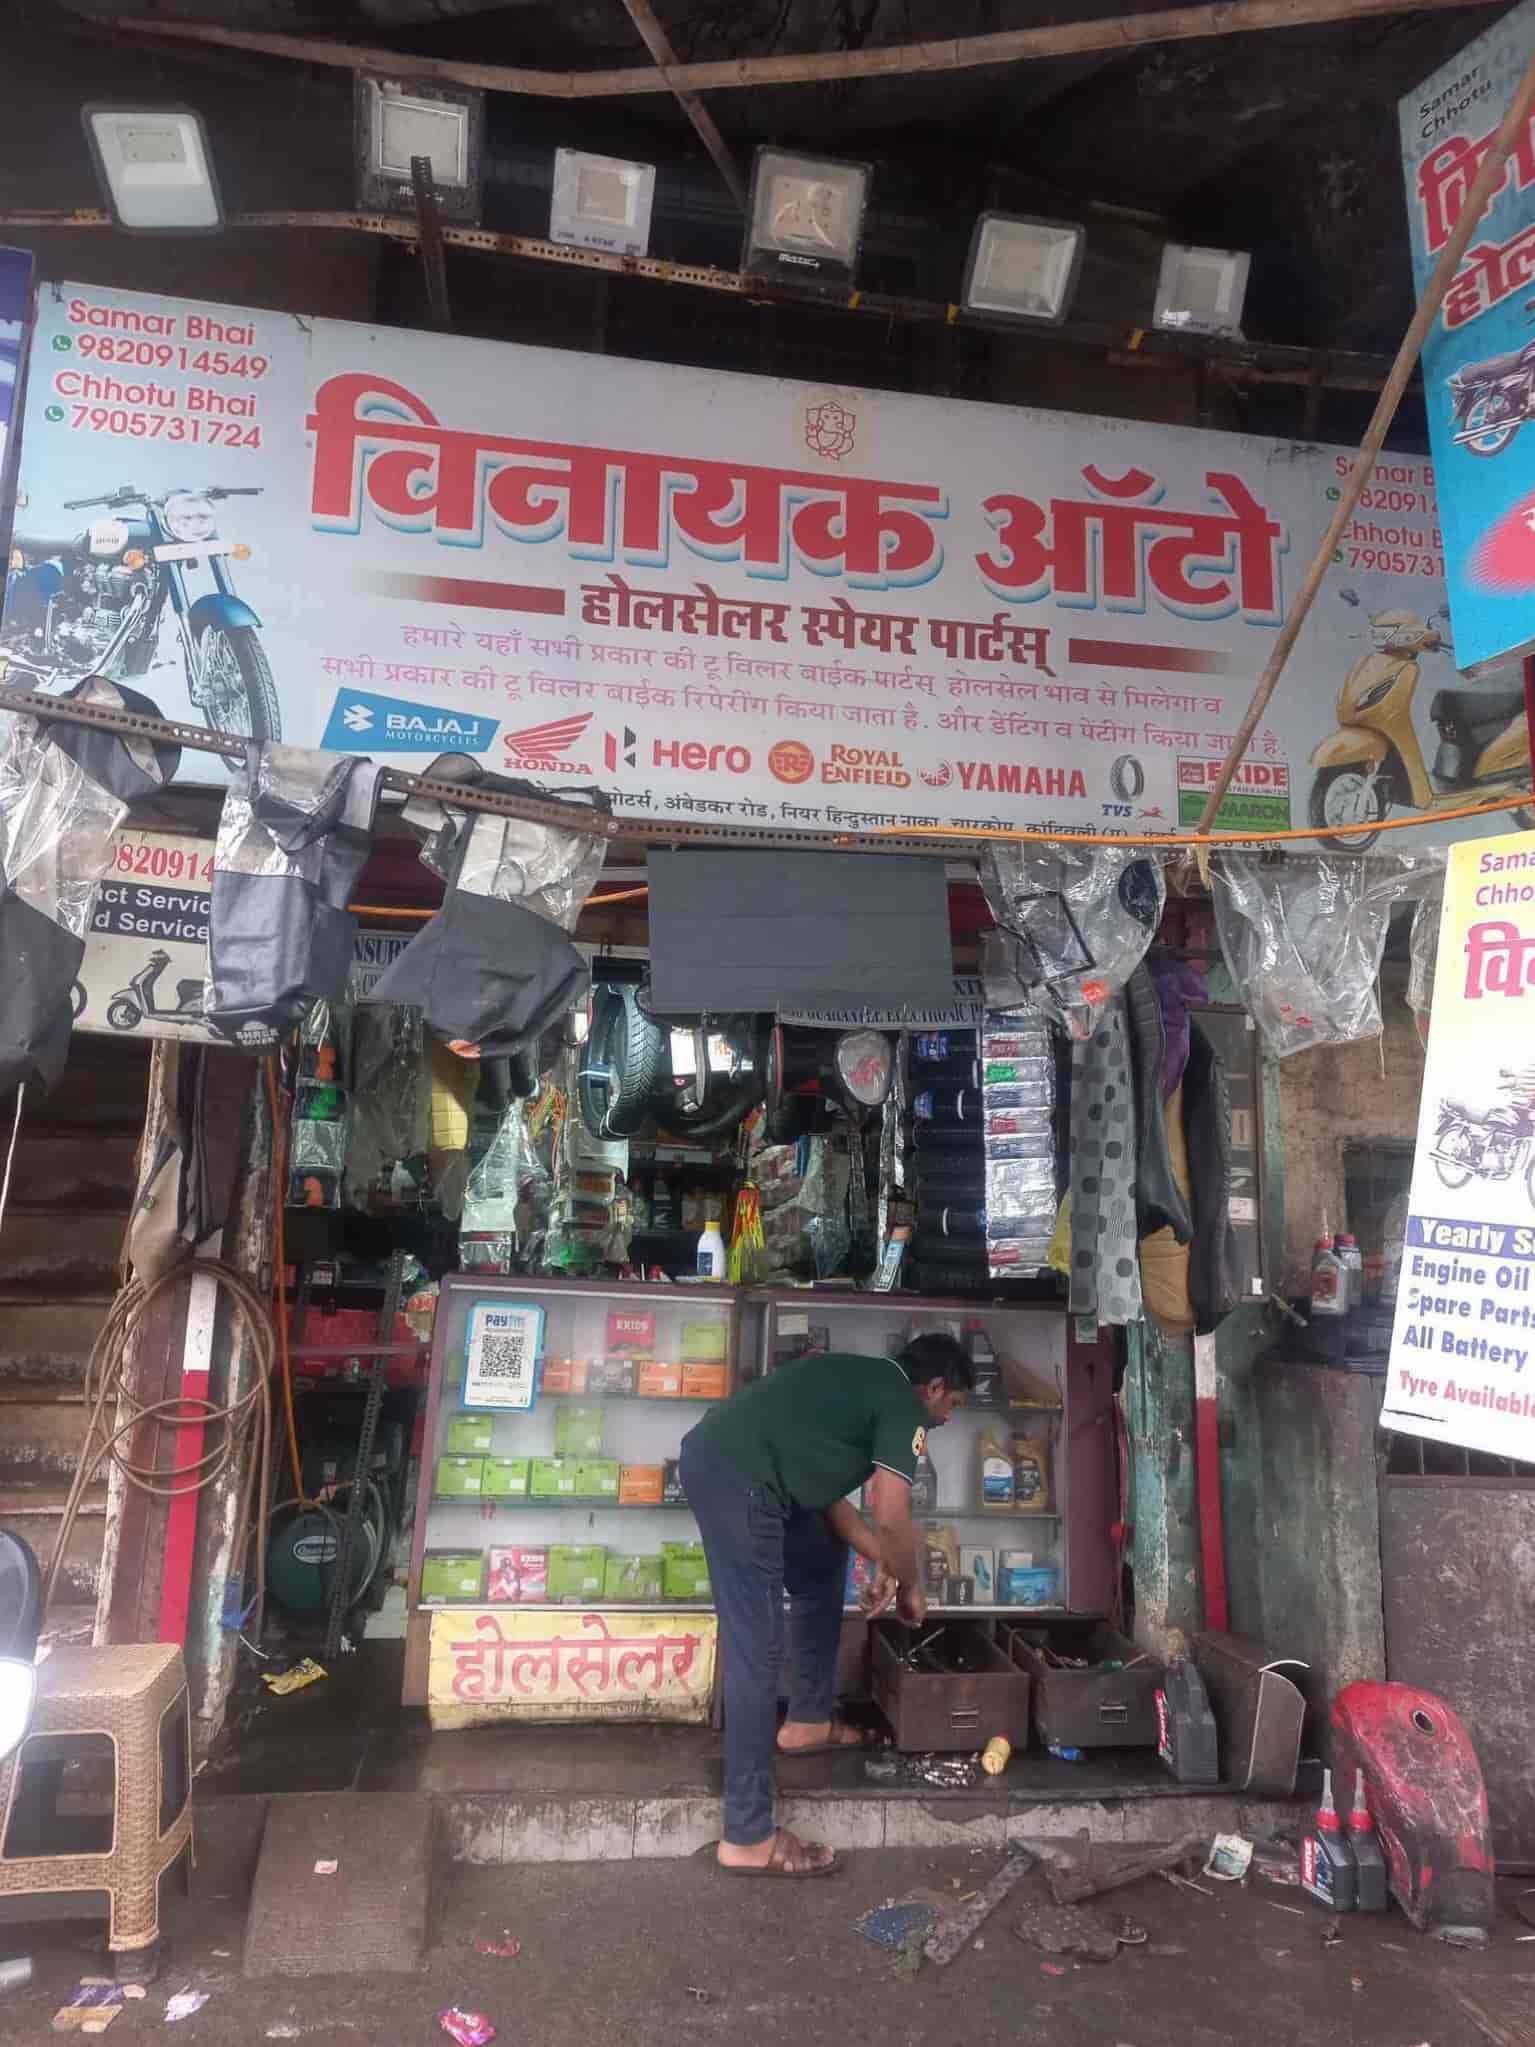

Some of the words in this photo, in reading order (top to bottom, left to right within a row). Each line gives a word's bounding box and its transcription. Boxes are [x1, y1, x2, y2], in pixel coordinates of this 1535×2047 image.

[1419, 66, 1480, 119] Samar
[1421, 79, 1492, 139] Chhotu
[68, 299, 176, 336] Samar
[185, 313, 256, 347] Bhai
[78, 334, 268, 380] 9820914549
[55, 370, 176, 409] Chhotu
[186, 386, 257, 418] Bhai
[71, 405, 261, 449] 7905731724
[304, 372, 944, 580] विनायक
[975, 463, 1284, 614] ऑटो
[1360, 487, 1437, 513] 82091
[580, 573, 791, 644] होलसेलर
[800, 597, 920, 656] स्पेयर
[927, 612, 1057, 677] पार्टस्
[401, 619, 466, 649] हमारे
[528, 635, 583, 660] सभी
[589, 643, 657, 667] प्रकार
[663, 645, 697, 671] की
[703, 655, 724, 680] टू
[726, 651, 792, 680] विलर
[947, 669, 1040, 699] होलसेल
[1043, 684, 1090, 705] भाव
[1096, 681, 1119, 706] से
[1124, 686, 1197, 713] मिलेगा
[1201, 697, 1224, 715] व
[320, 654, 376, 680] सभी
[384, 663, 456, 687] प्रकार
[462, 665, 498, 690] की
[504, 674, 525, 701] टू
[527, 671, 600, 699] विलर
[775, 693, 836, 722] किया
[841, 704, 898, 727] जाता
[936, 705, 985, 734] और
[1054, 721, 1075, 739] व
[1143, 722, 1201, 749] किया
[384, 731, 480, 746] MOTORCYCLES
[386, 714, 479, 736] BAJAJ
[504, 757, 594, 776] HONDA
[653, 739, 752, 774] Hero
[957, 762, 1088, 799] YAMAHA
[780, 802, 822, 822] नियर
[1102, 803, 1134, 818] TVS
[112, 843, 215, 882] 820914
[1420, 1218, 1505, 1255] Yearly
[1412, 1255, 1486, 1286] Engine
[1495, 1265, 1530, 1292] Oil
[1408, 1288, 1471, 1317] Spare
[1480, 1299, 1535, 1329] Parts
[1402, 1325, 1433, 1350] All
[1441, 1331, 1528, 1373] Battery
[1400, 1370, 1438, 1397] Tyre
[450, 1614, 701, 1699] होलसेलर
